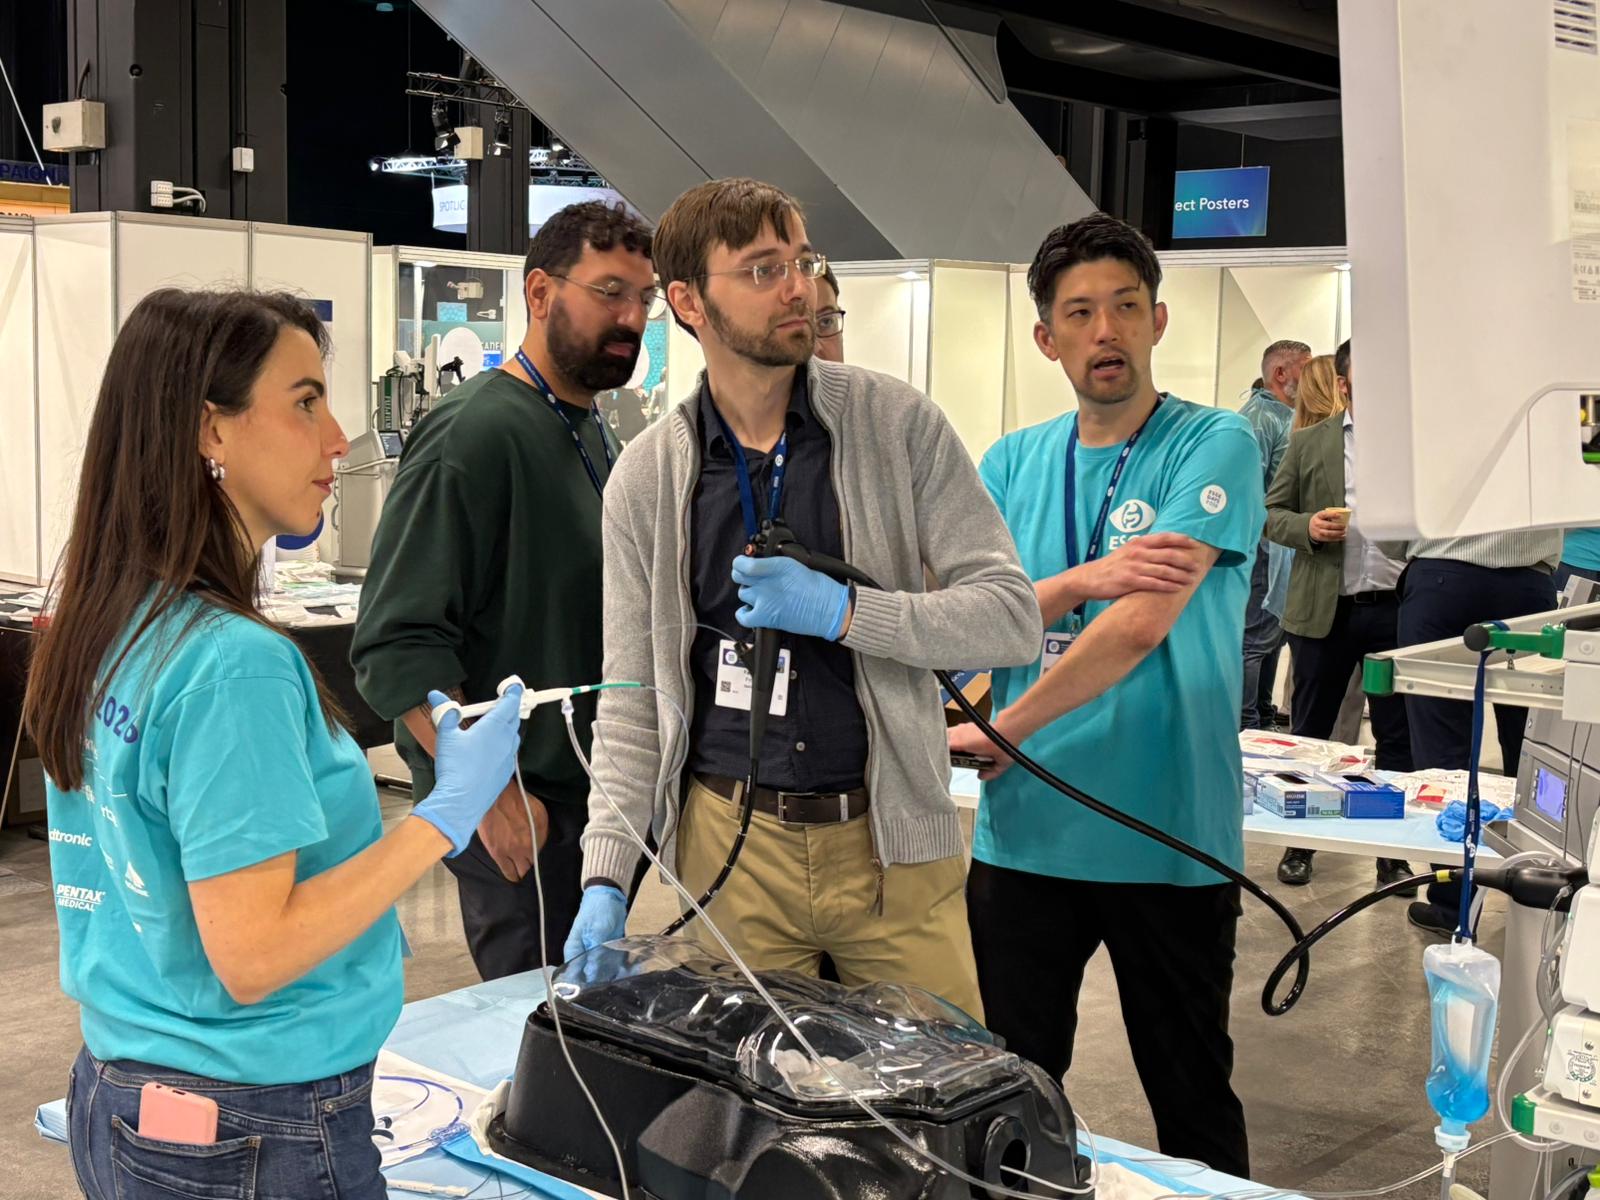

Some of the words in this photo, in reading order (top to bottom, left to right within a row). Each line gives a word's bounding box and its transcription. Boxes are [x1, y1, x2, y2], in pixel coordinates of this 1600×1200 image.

[1199, 197, 1250, 210] Posters
[56, 884, 103, 903] PENTAX
[57, 897, 96, 912] MEDICAL
